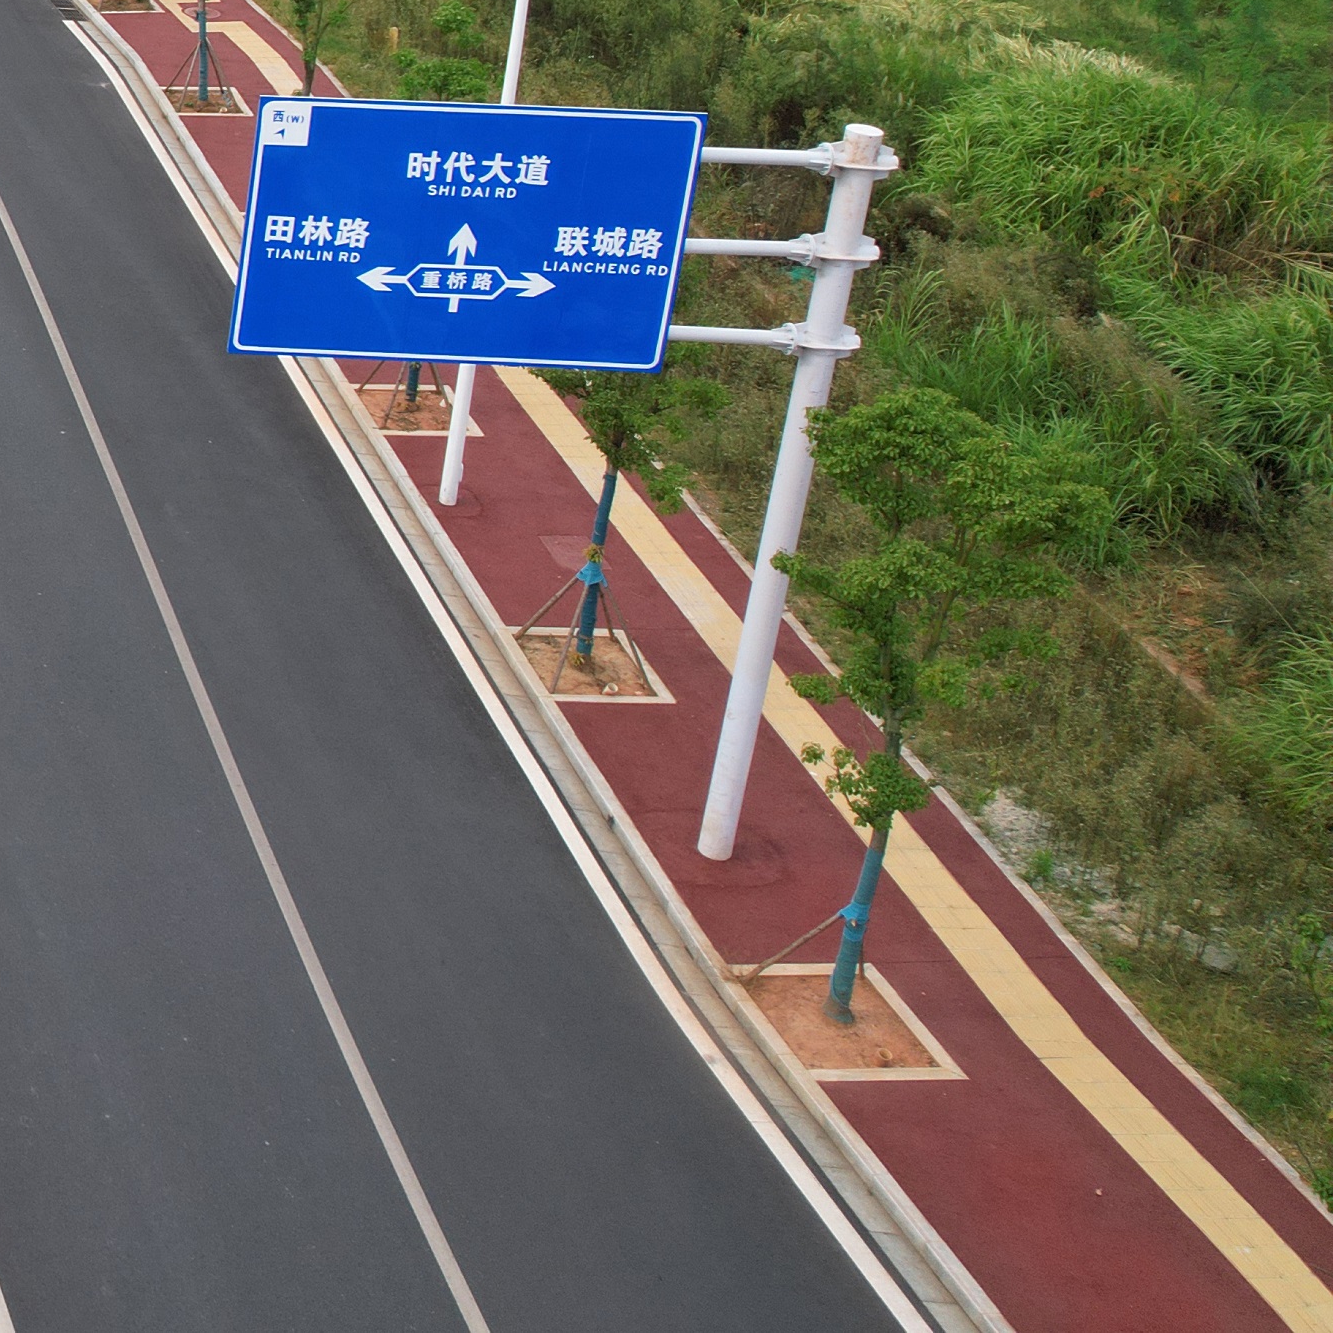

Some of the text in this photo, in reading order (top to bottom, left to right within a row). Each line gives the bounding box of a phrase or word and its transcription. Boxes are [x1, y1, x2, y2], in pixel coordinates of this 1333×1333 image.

[406, 150, 551, 186] 时代大道
[427, 184, 518, 199] SHI DAI RD
[264, 215, 370, 249] 田林路
[554, 226, 663, 260] 联城路
[265, 247, 361, 264] TIANLIN RD
[542, 260, 669, 277] LIANCHENG RD
[420, 270, 493, 291] 重桥路
